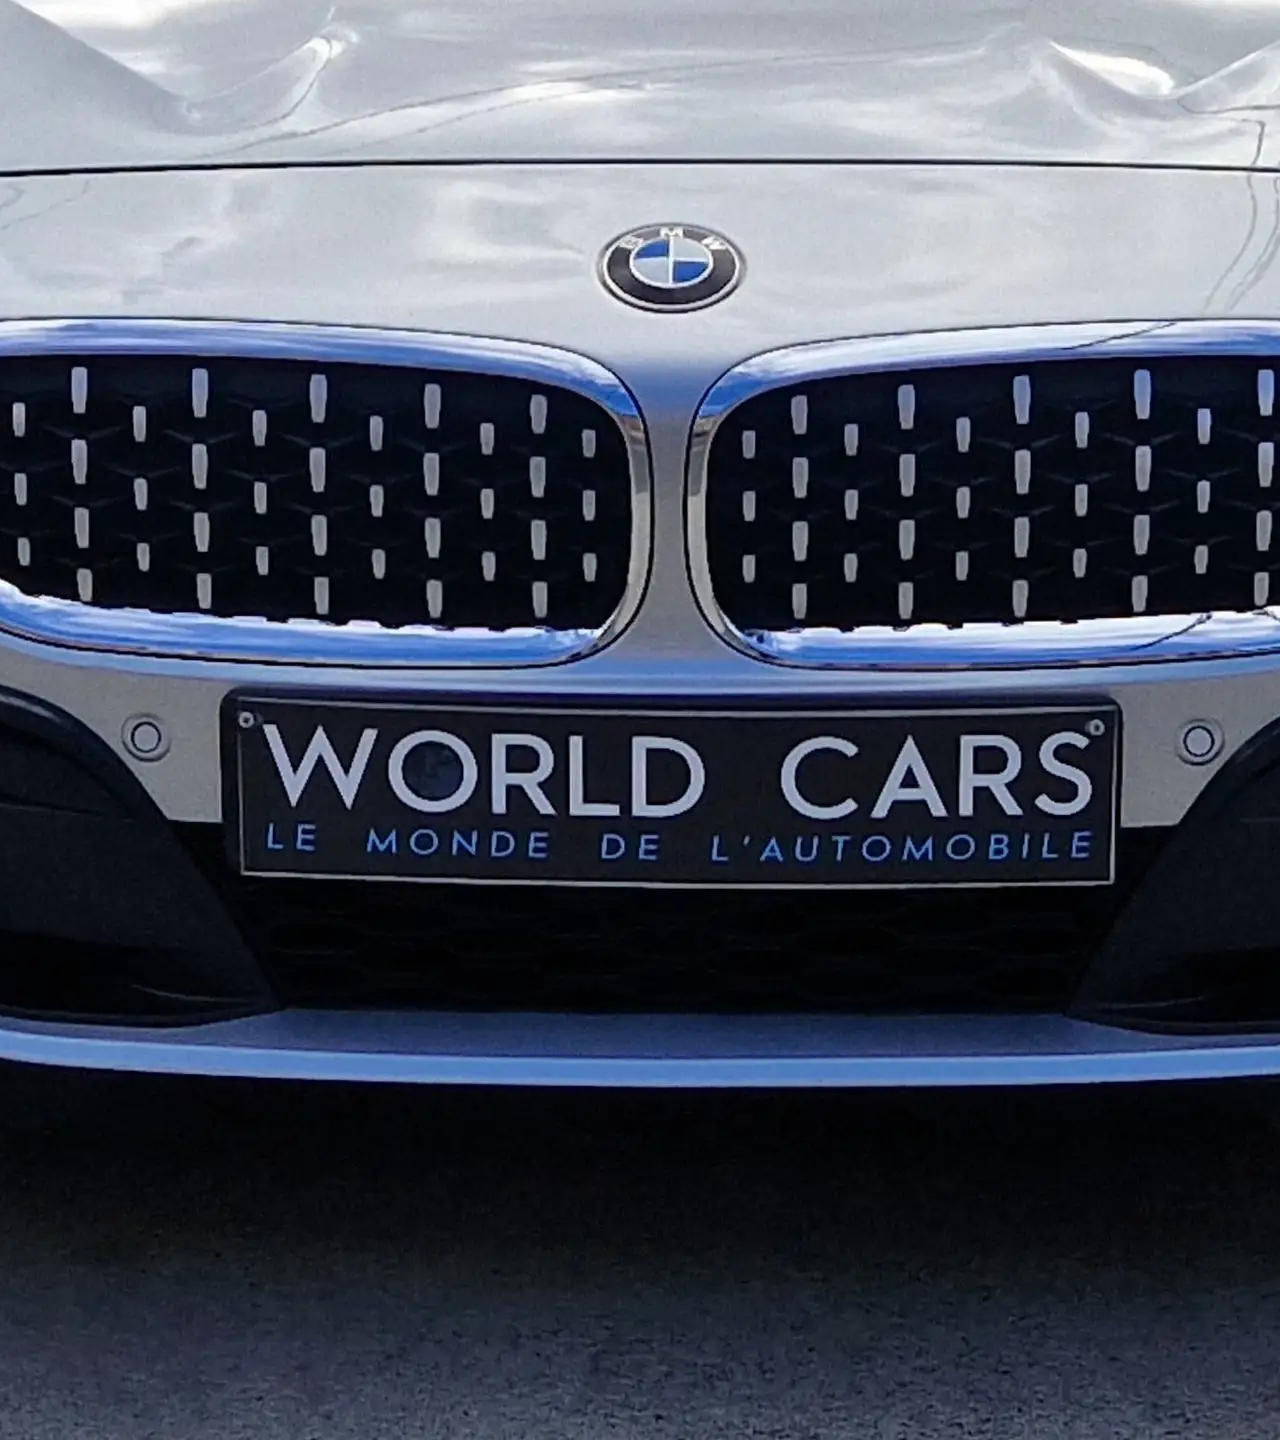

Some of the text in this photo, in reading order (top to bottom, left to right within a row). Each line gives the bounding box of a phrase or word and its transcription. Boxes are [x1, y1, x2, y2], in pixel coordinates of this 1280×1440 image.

[262, 724, 1093, 820] WORLD CARS
[266, 823, 1093, 862] LE MONDE DE L'AUTOMOBILE
